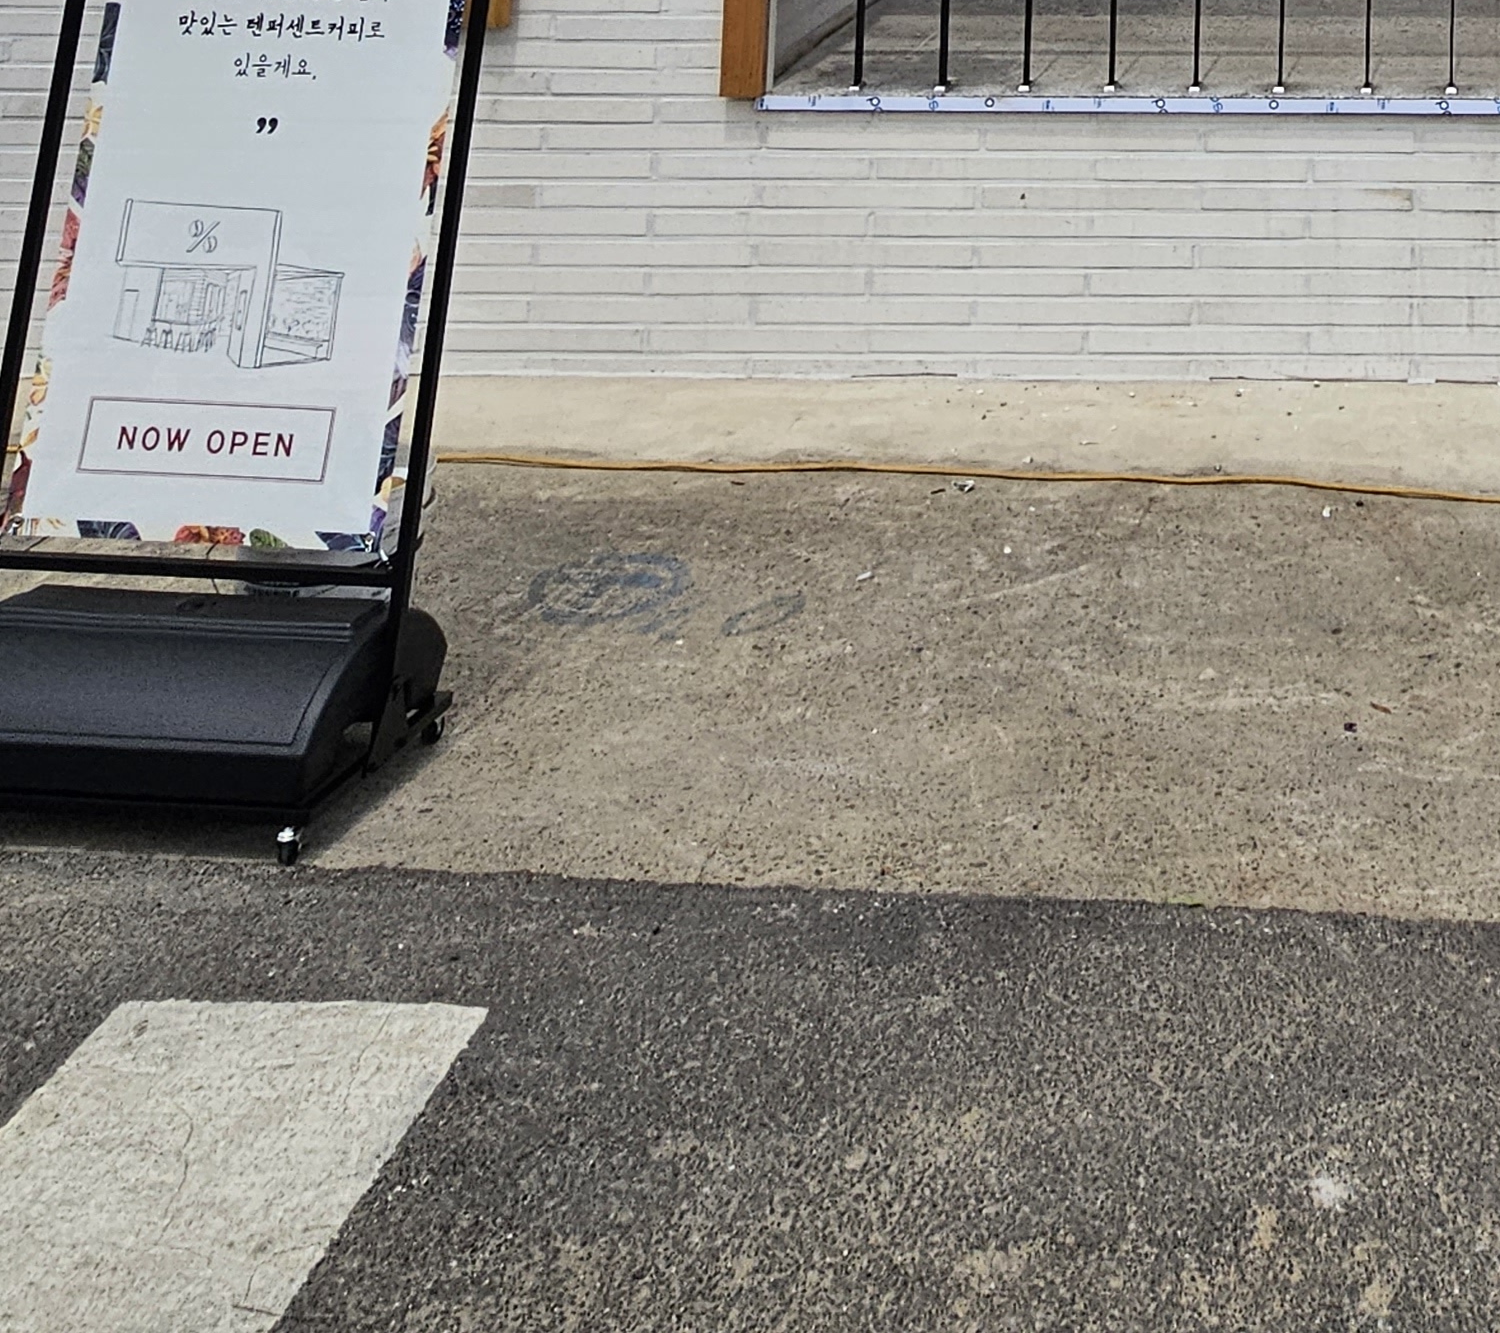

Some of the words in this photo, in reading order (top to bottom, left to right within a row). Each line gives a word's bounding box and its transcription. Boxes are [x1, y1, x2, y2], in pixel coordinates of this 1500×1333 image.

[178, 10, 238, 35] 맛있는
[246, 12, 386, 42] 텐퍼센트커피로
[233, 52, 318, 81] 있을게요.
[117, 425, 191, 452] NOW
[206, 429, 295, 458] OPEN
